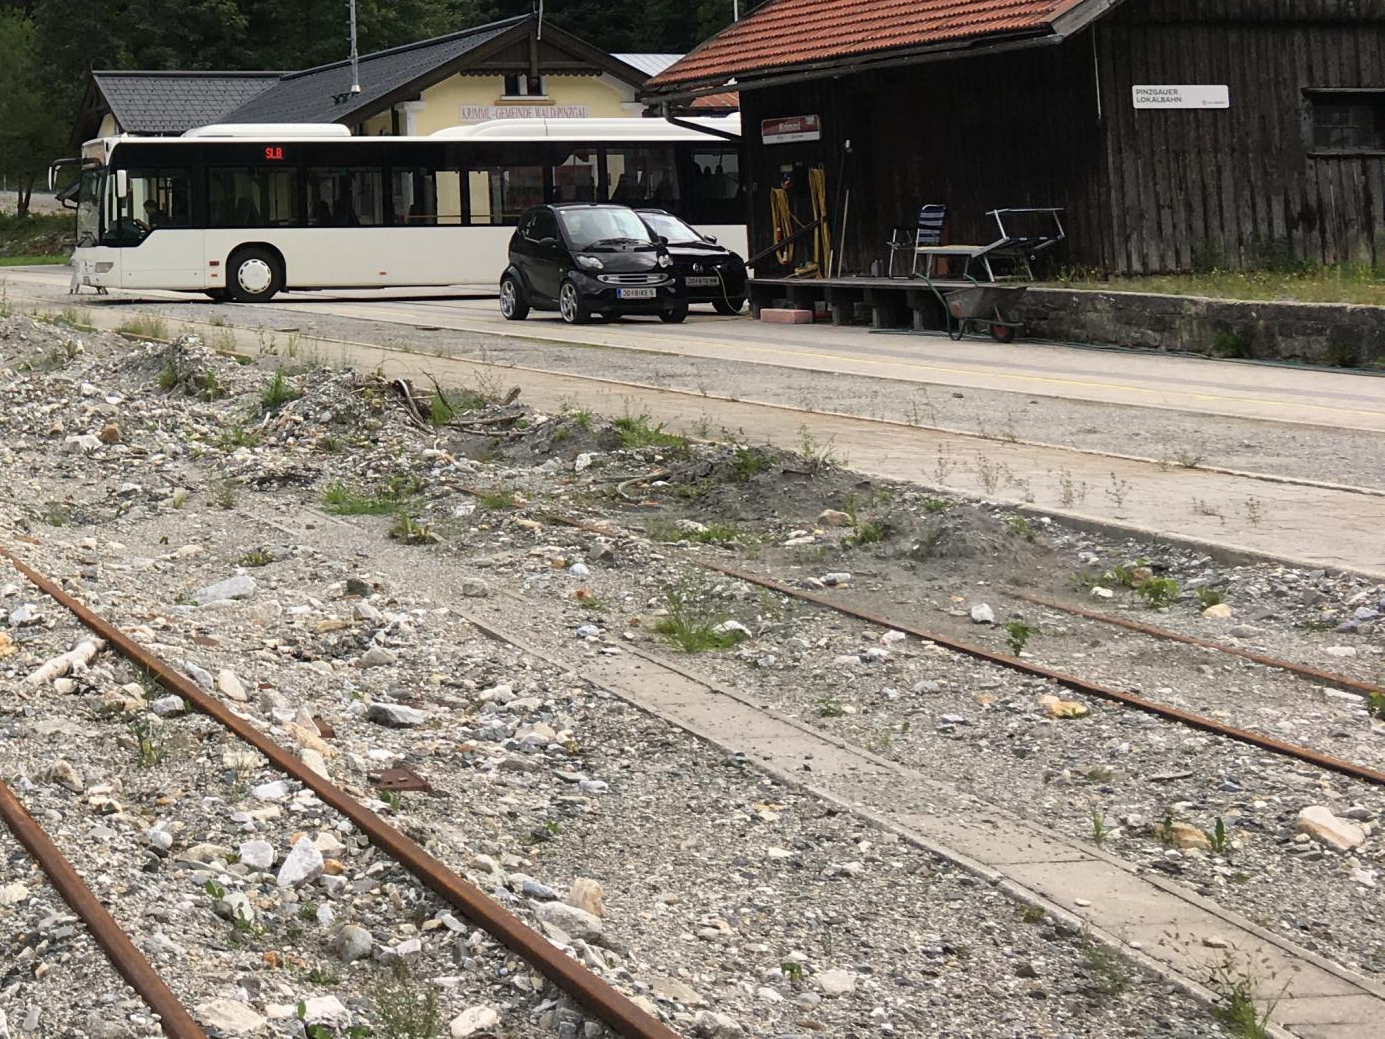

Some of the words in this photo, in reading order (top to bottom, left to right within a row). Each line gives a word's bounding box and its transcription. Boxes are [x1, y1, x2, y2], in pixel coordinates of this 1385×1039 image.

[1135, 88, 1179, 96] PINZGAUER
[1136, 96, 1182, 104] LOKALBAHN
[265, 147, 282, 159] SLB
